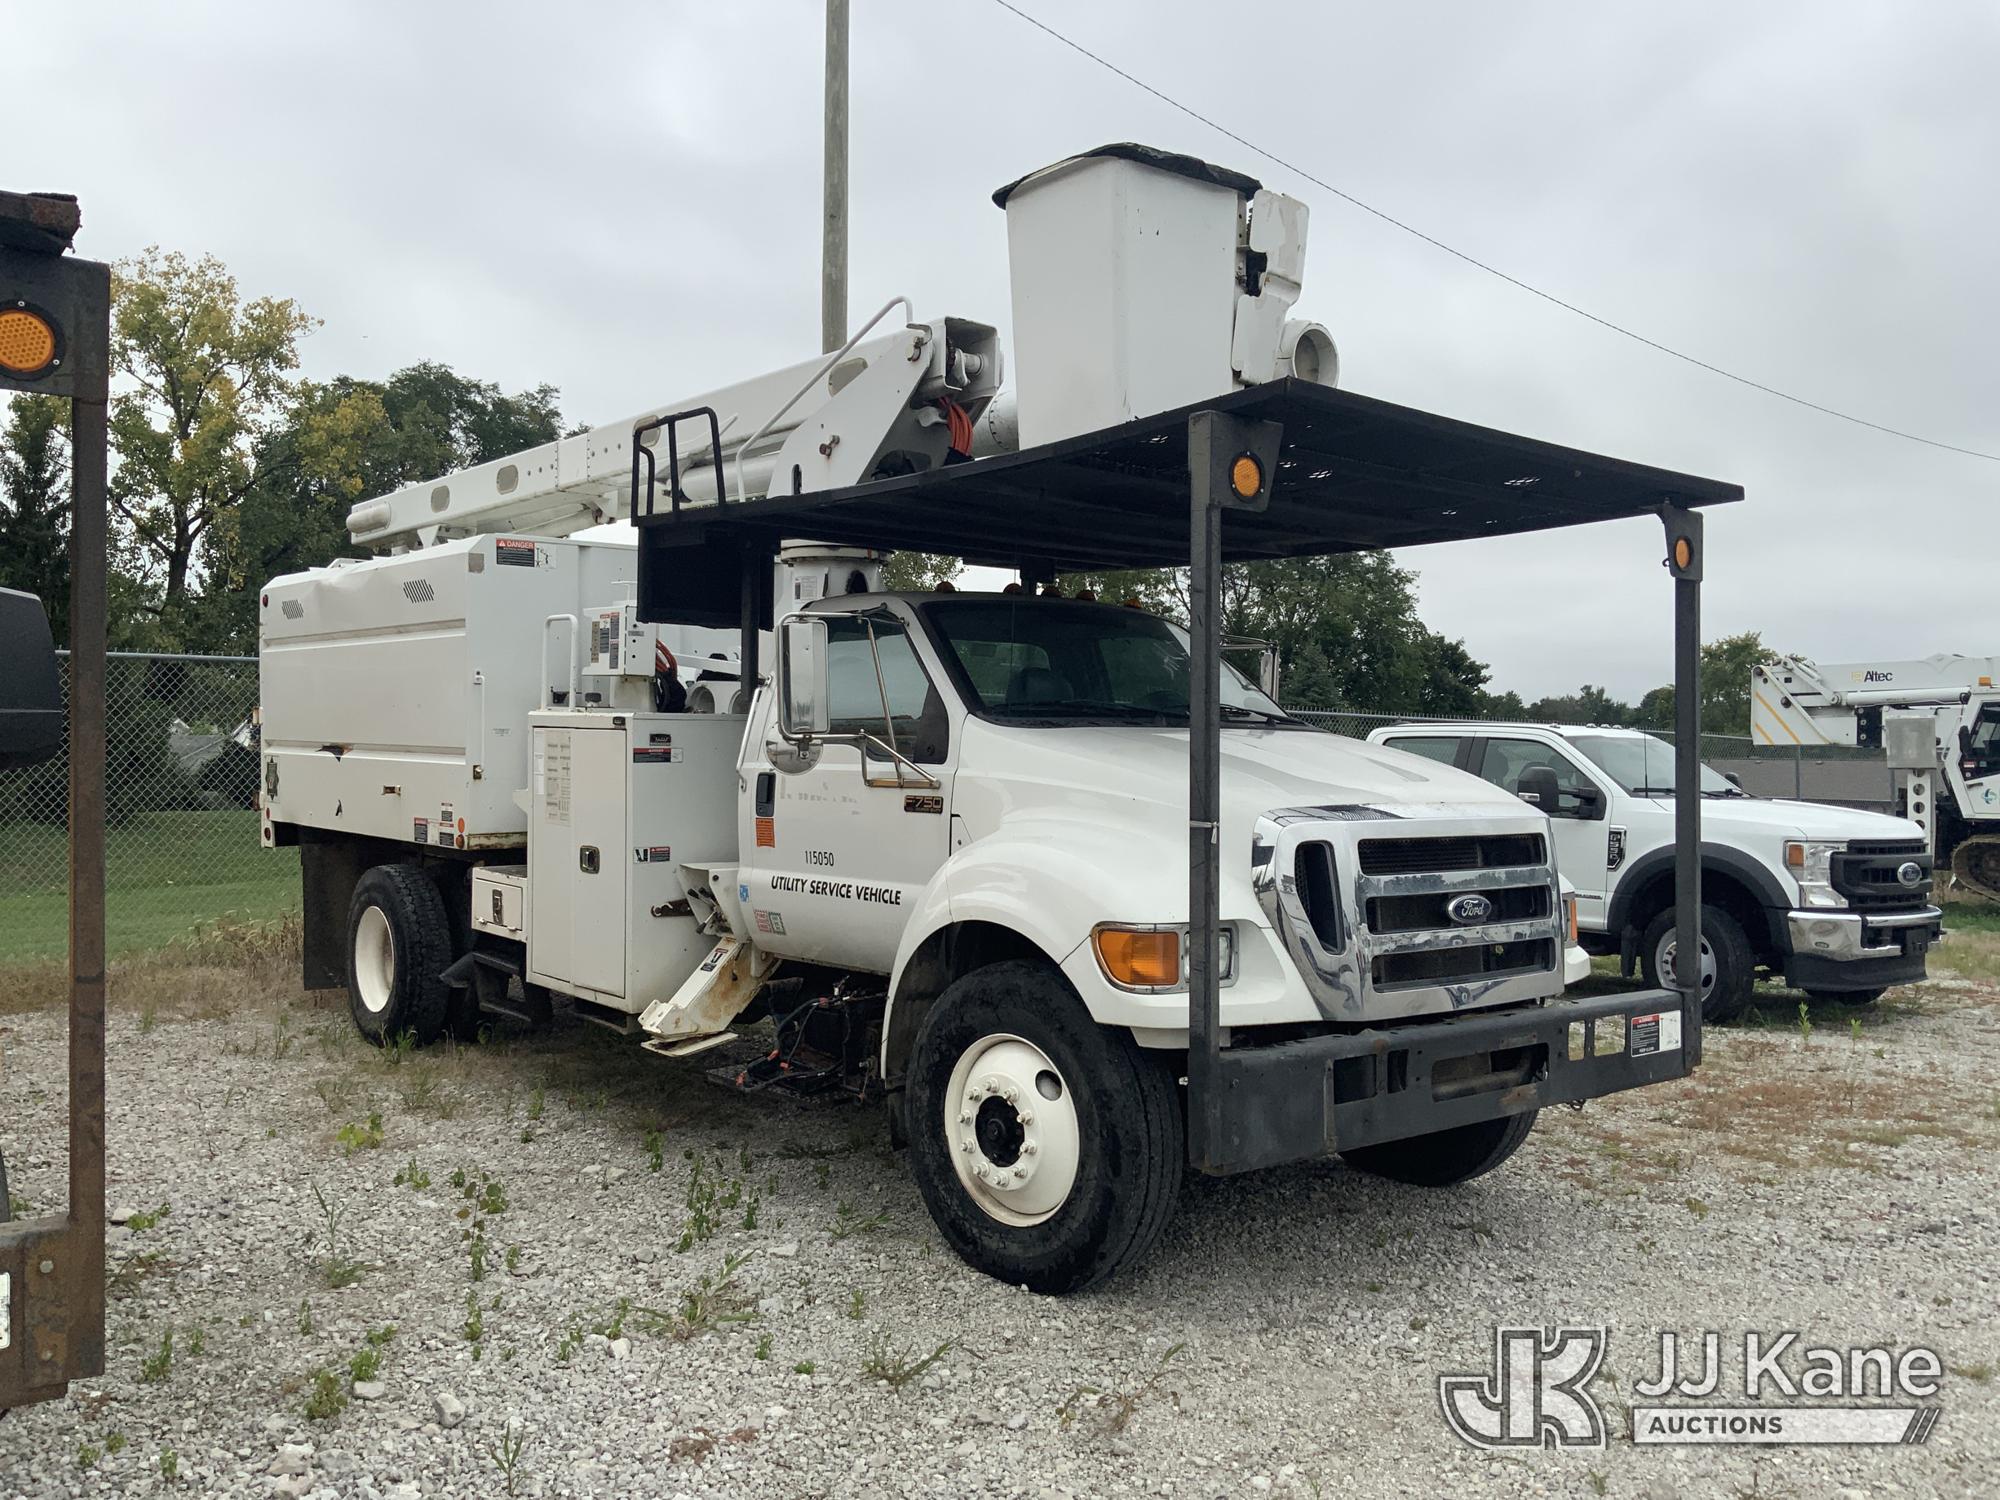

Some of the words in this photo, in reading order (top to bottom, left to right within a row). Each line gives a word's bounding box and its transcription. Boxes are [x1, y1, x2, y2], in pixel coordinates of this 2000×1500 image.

[506, 540, 534, 549] DANGER
[1864, 670, 1893, 682] Altec
[805, 850, 835, 867] 115050
[771, 875, 808, 893] UTILITY
[809, 880, 853, 899] SERVICE
[856, 885, 902, 906] VEHICLE
[1461, 899, 1484, 917] Ford
